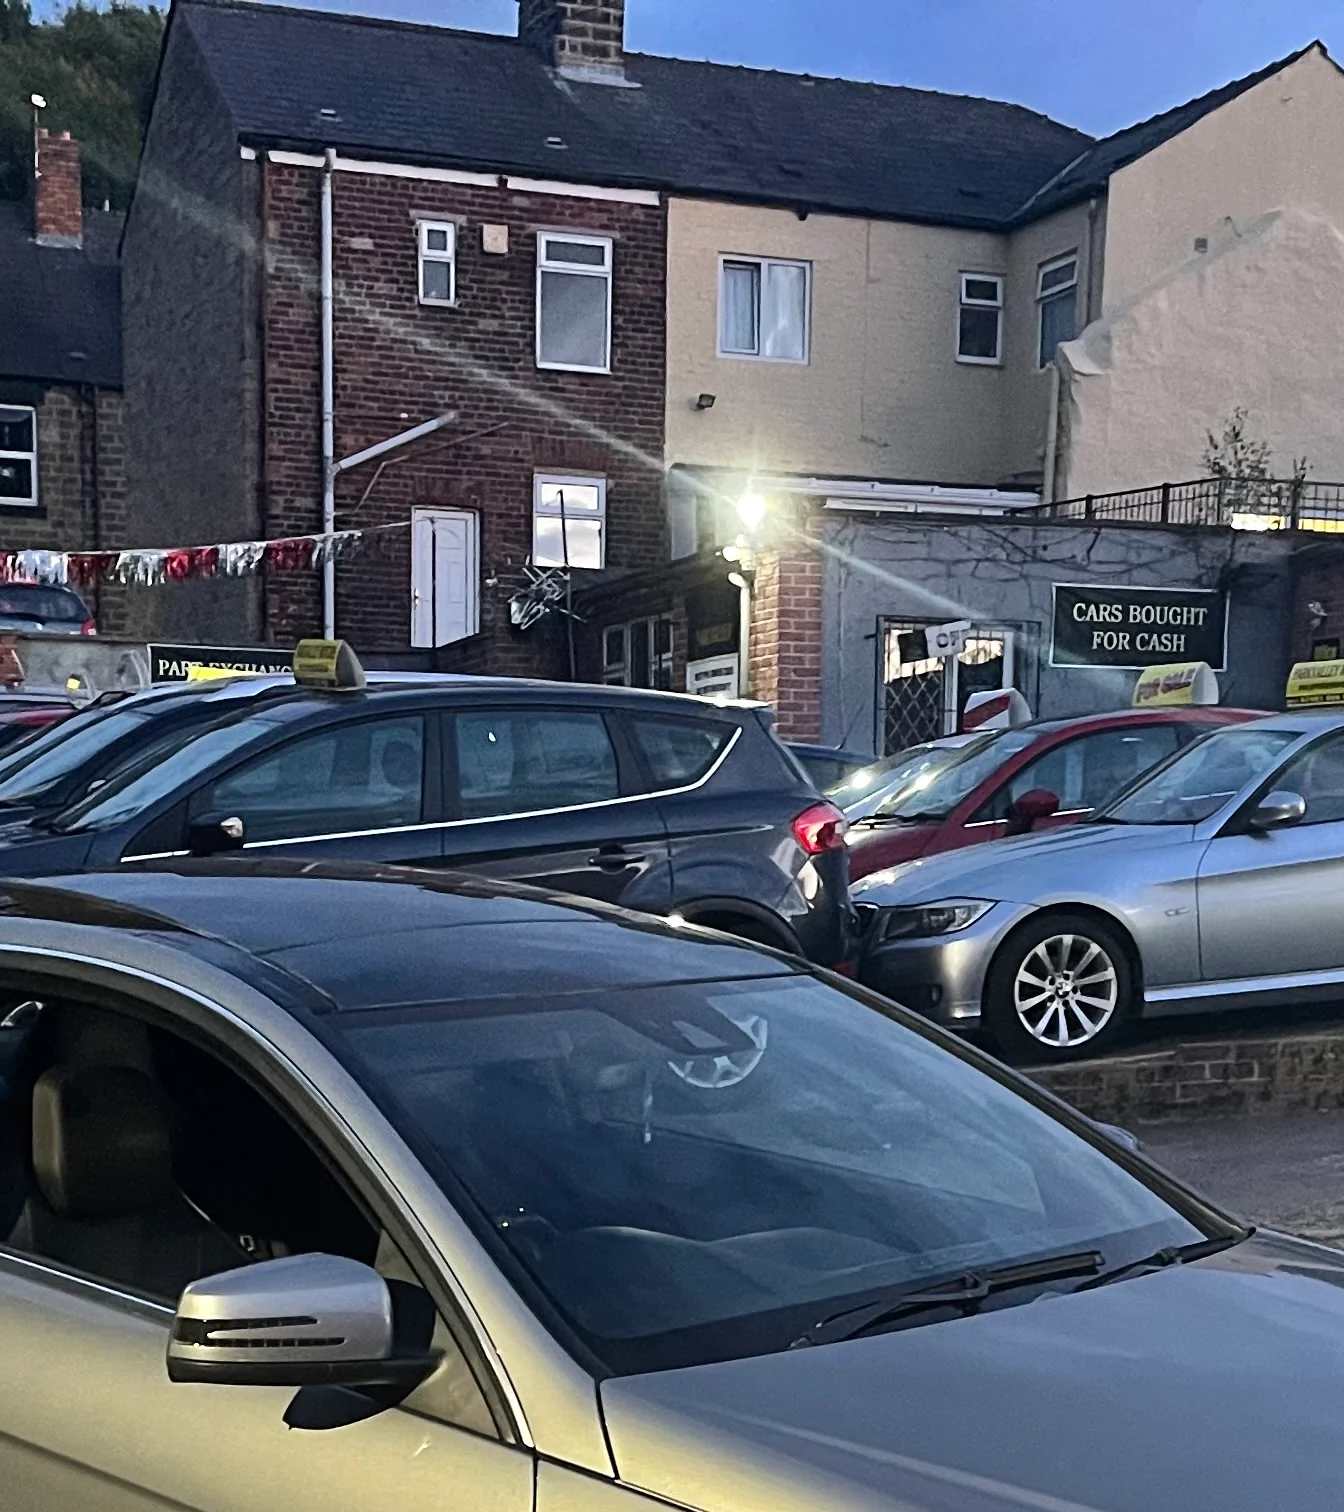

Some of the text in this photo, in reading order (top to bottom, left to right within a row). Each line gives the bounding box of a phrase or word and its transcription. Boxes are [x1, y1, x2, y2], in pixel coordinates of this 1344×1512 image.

[1072, 603, 1208, 626] CARS BOUGHT
[1092, 631, 1185, 652] FOR CASH
